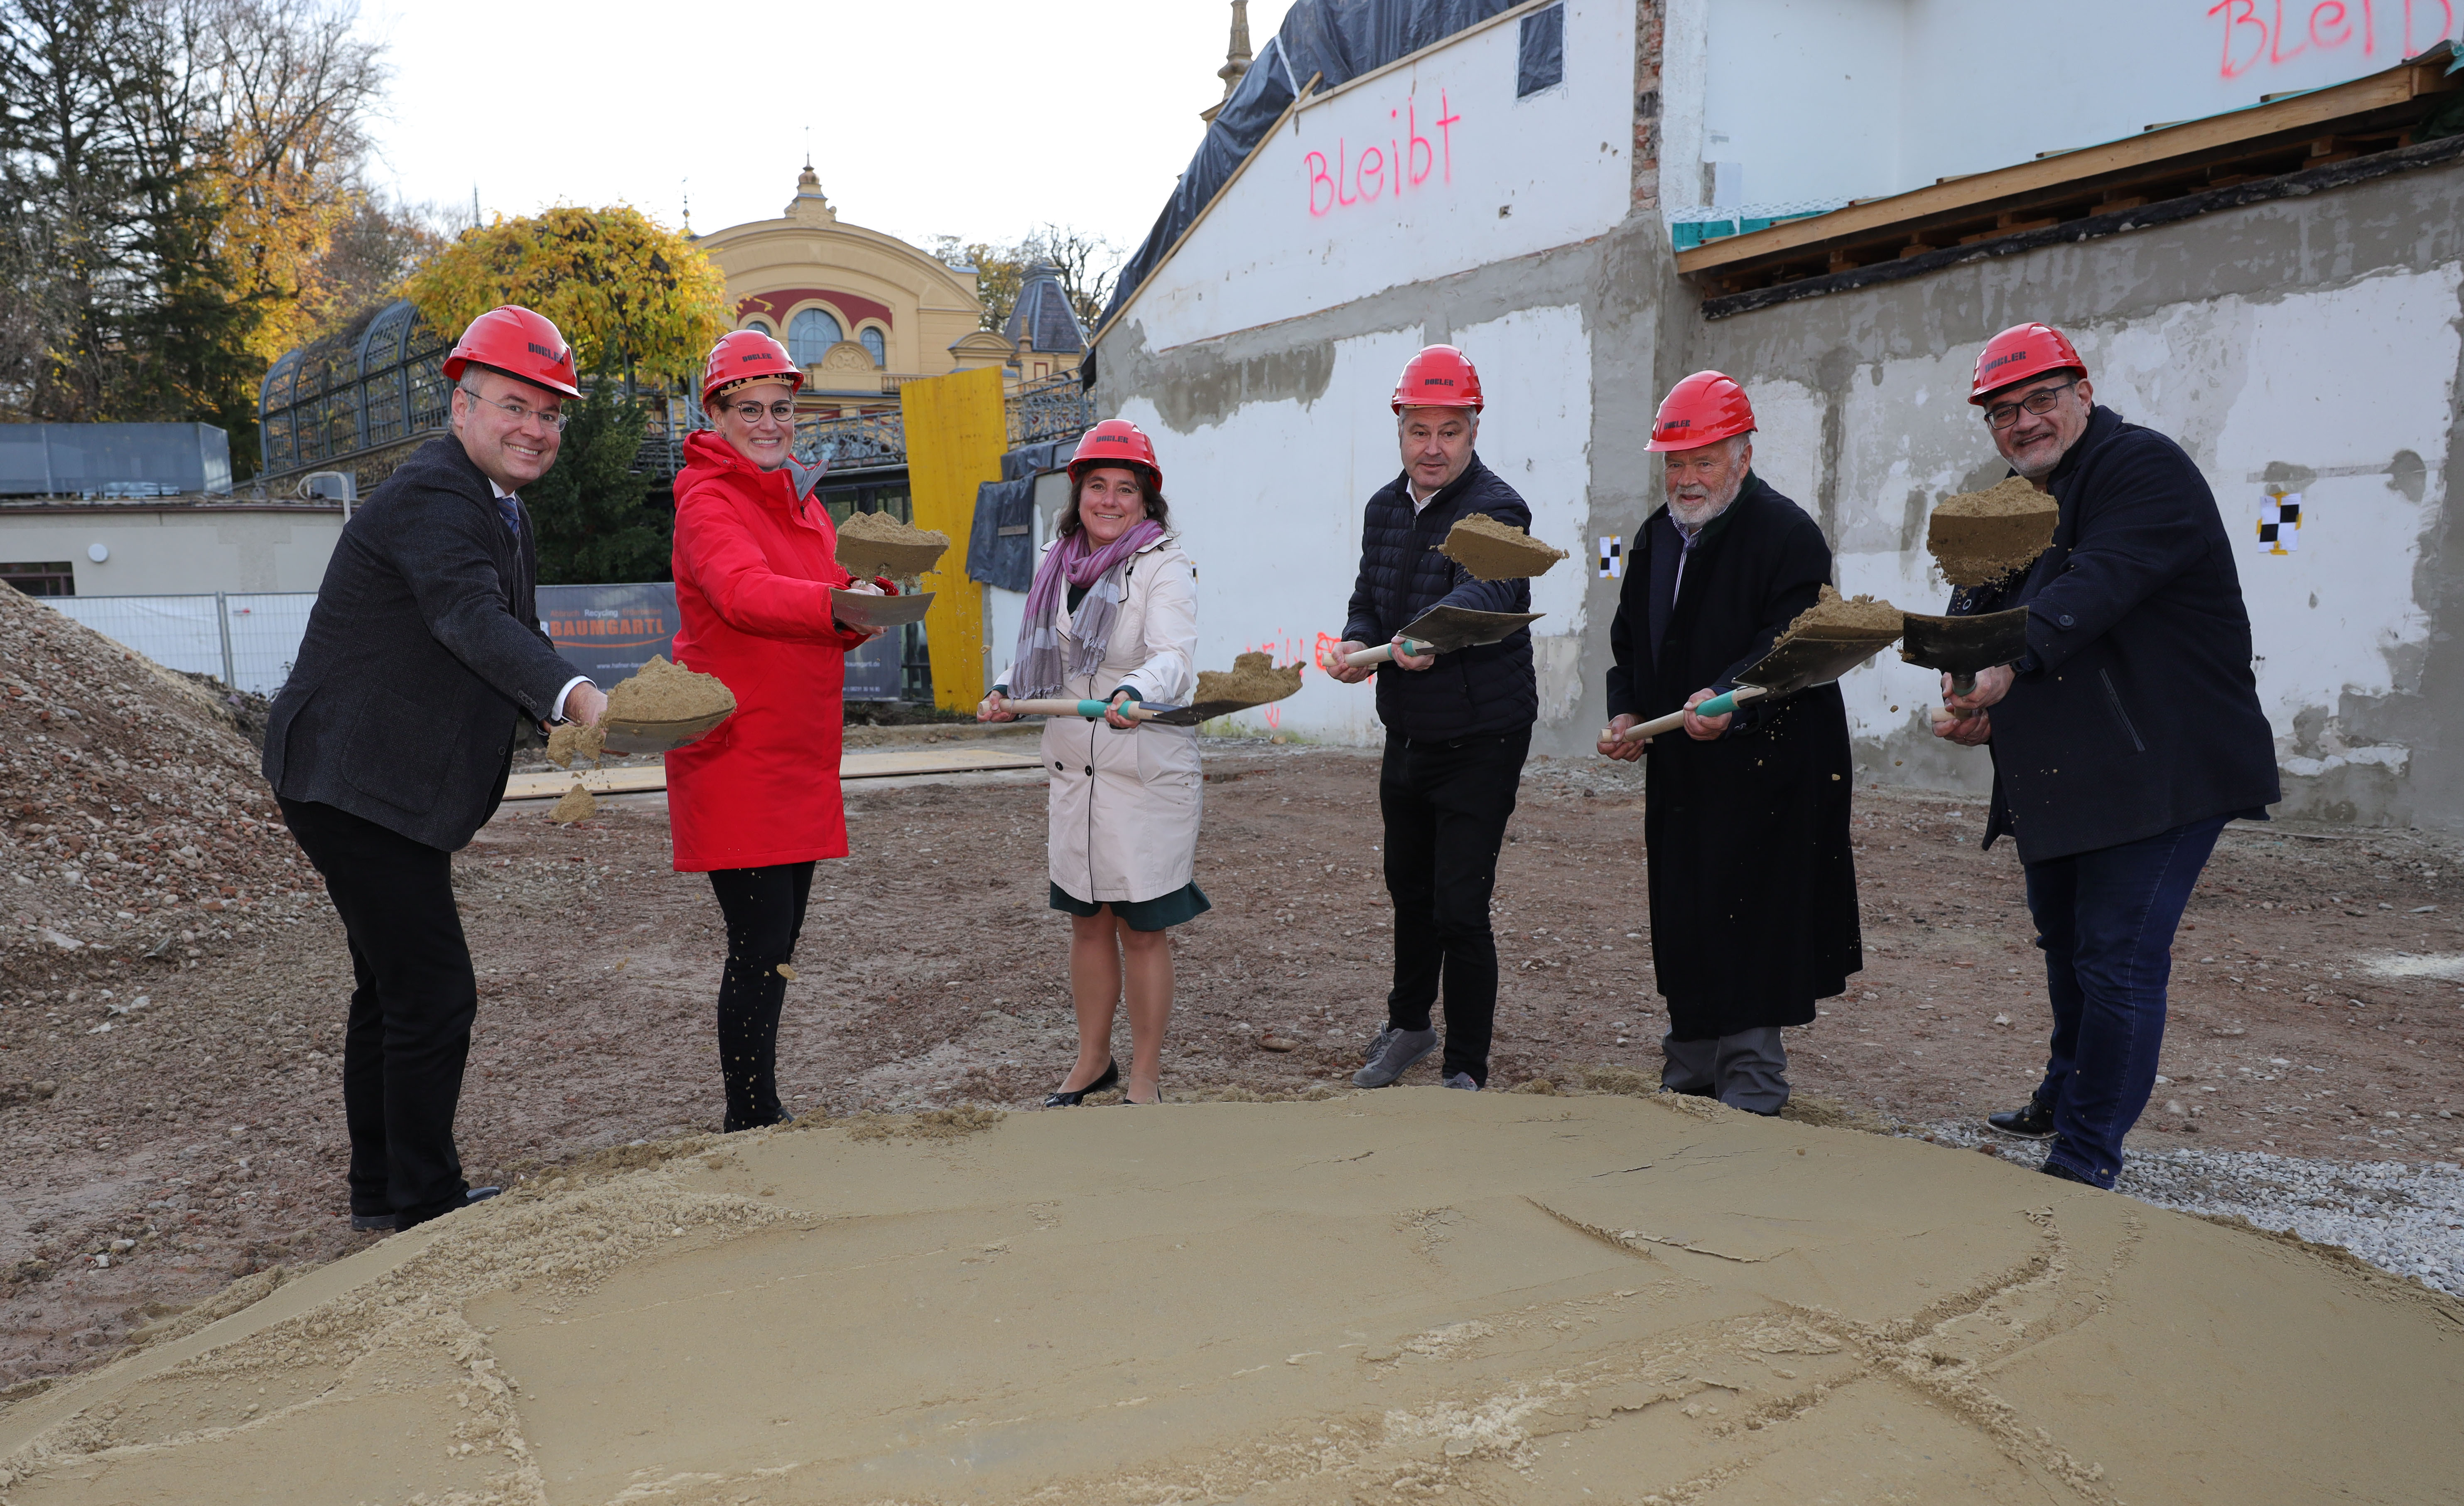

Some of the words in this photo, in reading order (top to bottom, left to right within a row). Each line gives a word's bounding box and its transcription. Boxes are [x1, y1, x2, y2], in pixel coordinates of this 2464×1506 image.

[742, 353, 773, 362] DOBLER
[1985, 351, 2027, 373] DOBLER
[1664, 419, 1691, 430] DOBLER
[1096, 435, 1129, 444] DOBLER
[584, 609, 618, 618] Recycling
